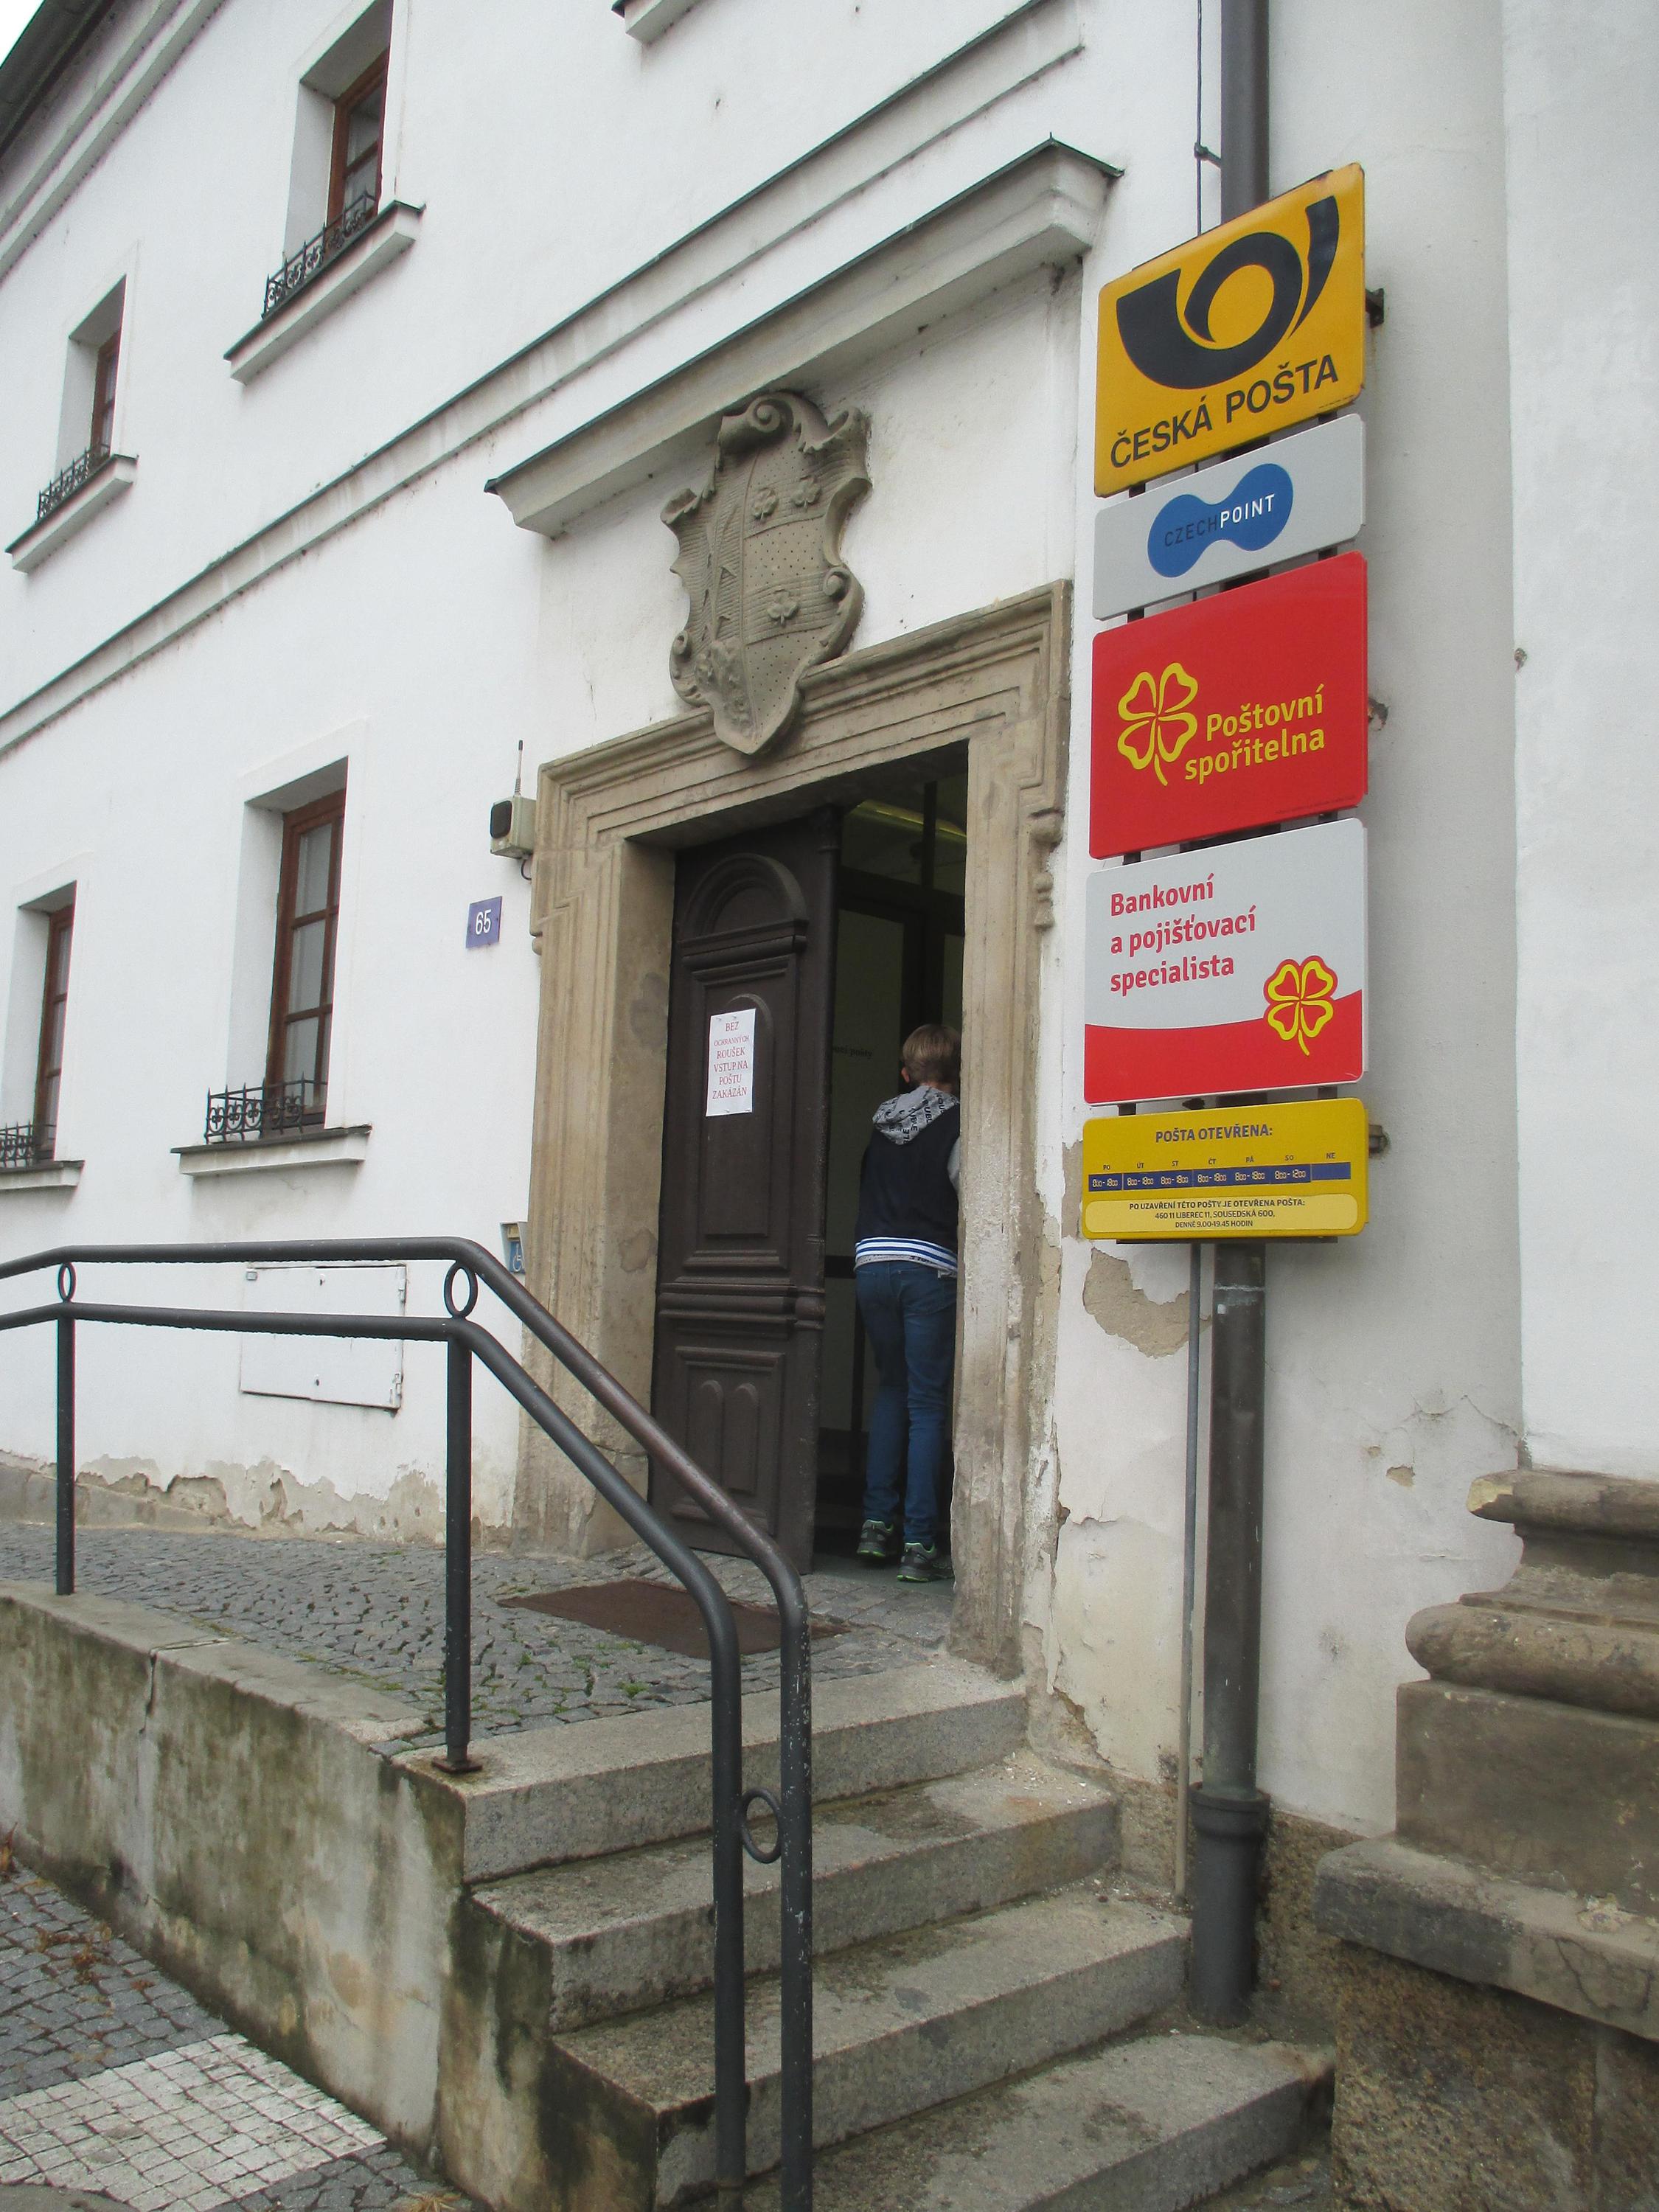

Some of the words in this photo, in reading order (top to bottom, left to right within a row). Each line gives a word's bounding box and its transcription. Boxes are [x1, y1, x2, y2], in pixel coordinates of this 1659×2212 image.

[1110, 395, 1213, 467] ČESKÁ
[1225, 354, 1339, 424] POŠTA
[1206, 684, 1324, 742] Poštovní
[1185, 728, 1325, 785] spořitelna
[1110, 872, 1214, 917] Bankovní
[476, 908, 492, 935] 65
[1110, 936, 1122, 954] a
[1130, 904, 1256, 958] pojišťovací
[1110, 954, 1234, 997] specialista
[726, 1021, 739, 1032] BEZ
[717, 1046, 745, 1059] ROUŠEK
[714, 1062, 737, 1072] VSTUP
[737, 1060, 748, 1070] NA
[719, 1074, 742, 1085] POŠTU
[712, 1085, 747, 1099] ZAKÁZÁN
[1155, 1127, 1195, 1143] POŠTA
[1198, 1123, 1273, 1140] OTEVŘENA:
[1141, 1201, 1175, 1209] UZAVŘENÍ
[1177, 1200, 1195, 1208] TÉTO
[1197, 1200, 1221, 1208] POŠTY
[1234, 1198, 1275, 1207] OTEVŘENA
[1276, 1197, 1305, 1206] POŠTA:
[1213, 1209, 1256, 1218] SOUSEDSKÁ
